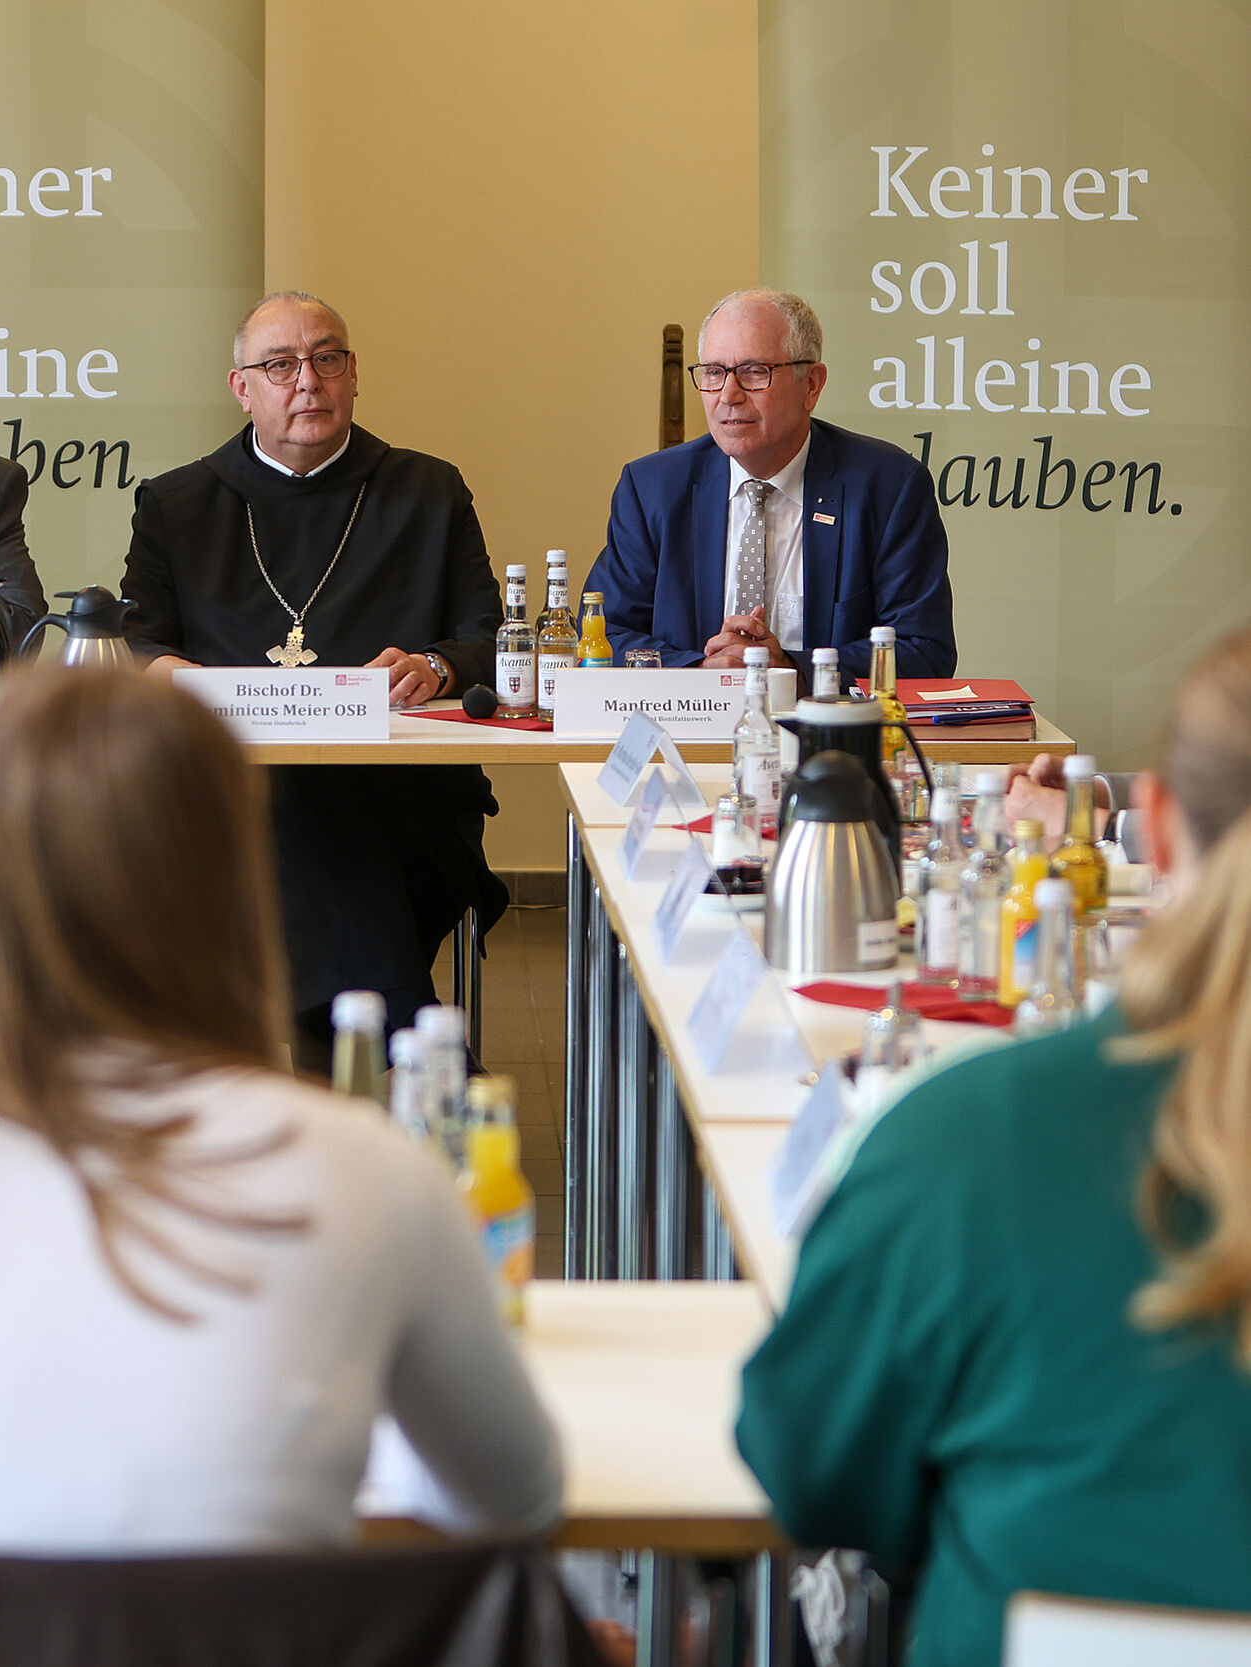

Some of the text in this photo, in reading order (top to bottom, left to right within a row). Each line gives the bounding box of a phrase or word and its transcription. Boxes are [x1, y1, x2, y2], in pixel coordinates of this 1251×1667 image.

[870, 143, 1149, 221] Keiner
[870, 240, 1015, 316] soll
[868, 335, 1152, 417] alleine
[209, 703, 367, 717] minicus Meier OSB
[236, 683, 323, 697] Bischof Dr.
[604, 698, 731, 712] Manfred Müller
